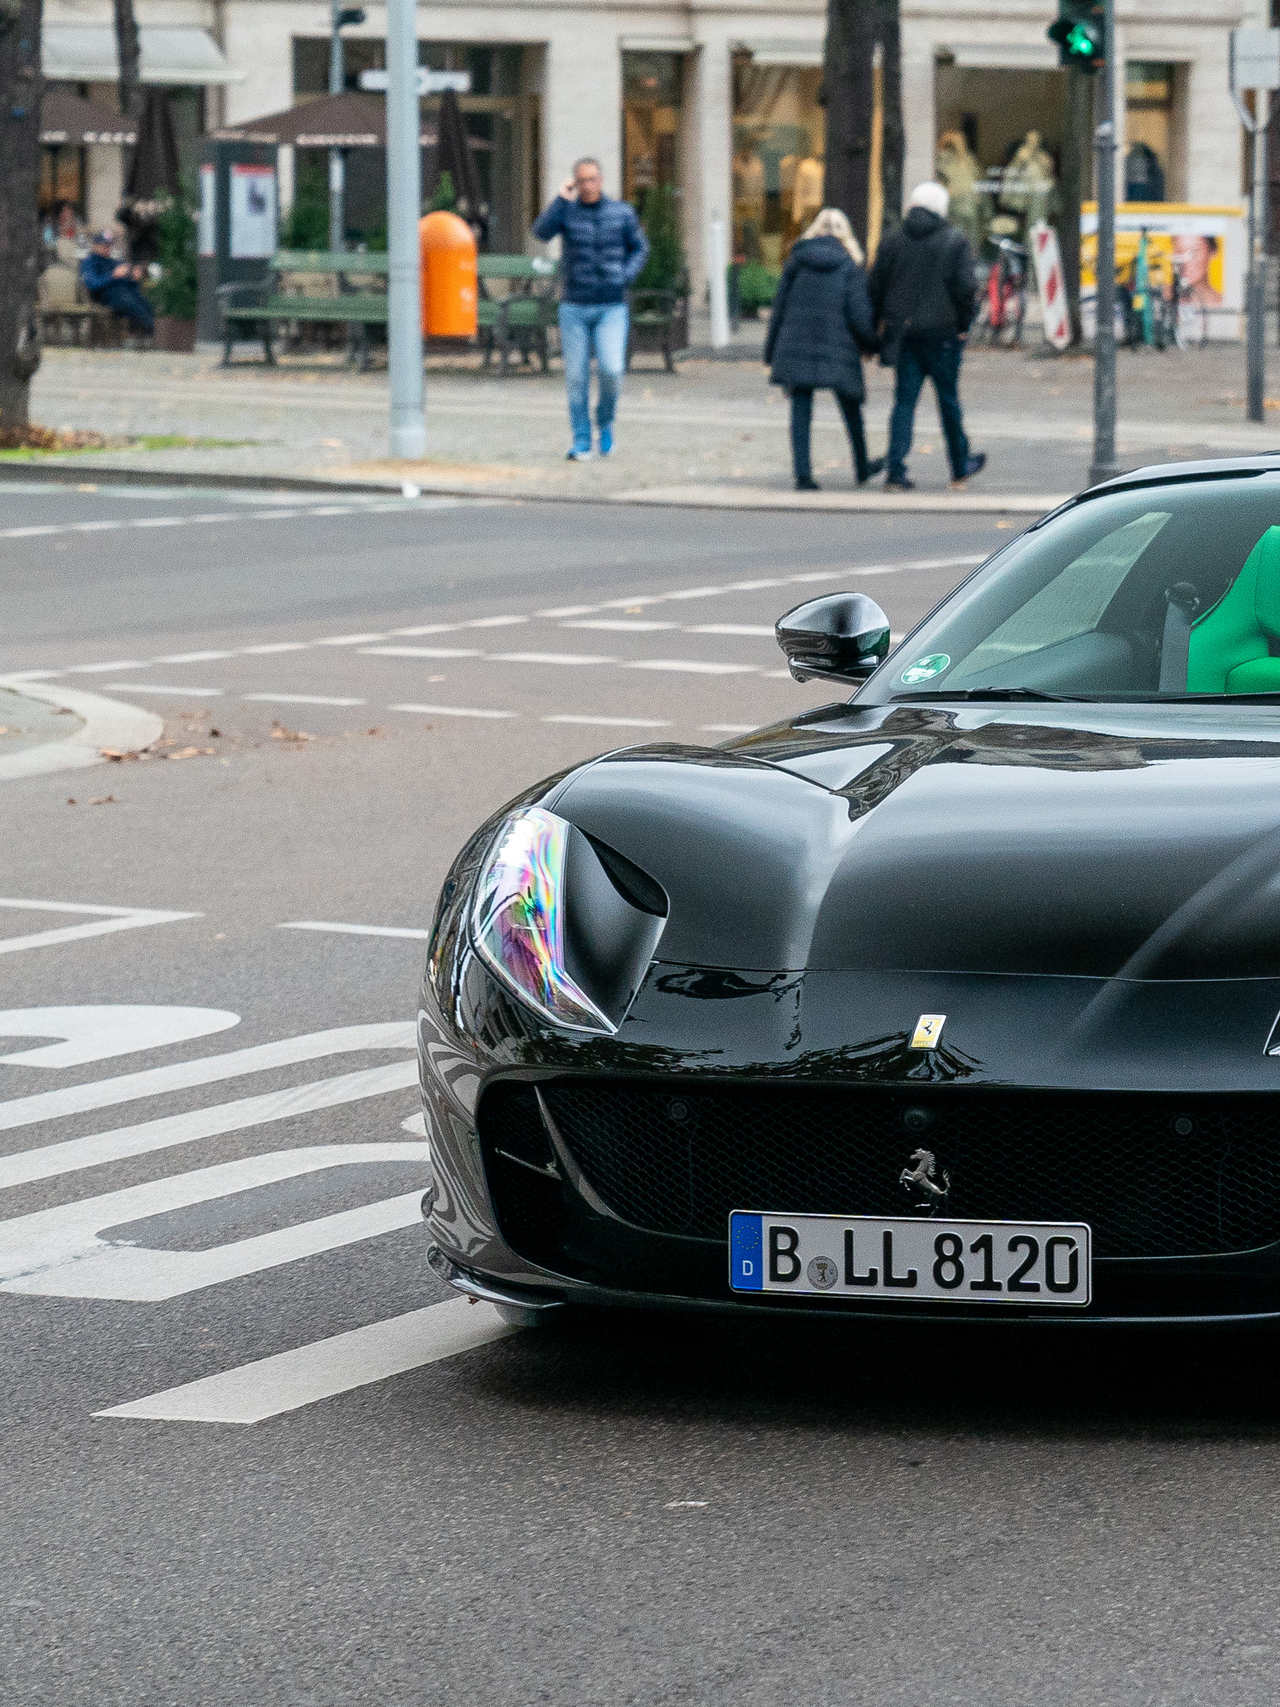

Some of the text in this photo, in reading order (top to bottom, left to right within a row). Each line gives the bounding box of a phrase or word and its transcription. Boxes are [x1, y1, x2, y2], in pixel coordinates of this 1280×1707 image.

[742, 1259, 753, 1276] D
[769, 1225, 801, 1282] B
[844, 1228, 917, 1287] LL
[932, 1231, 1079, 1293] 8120
